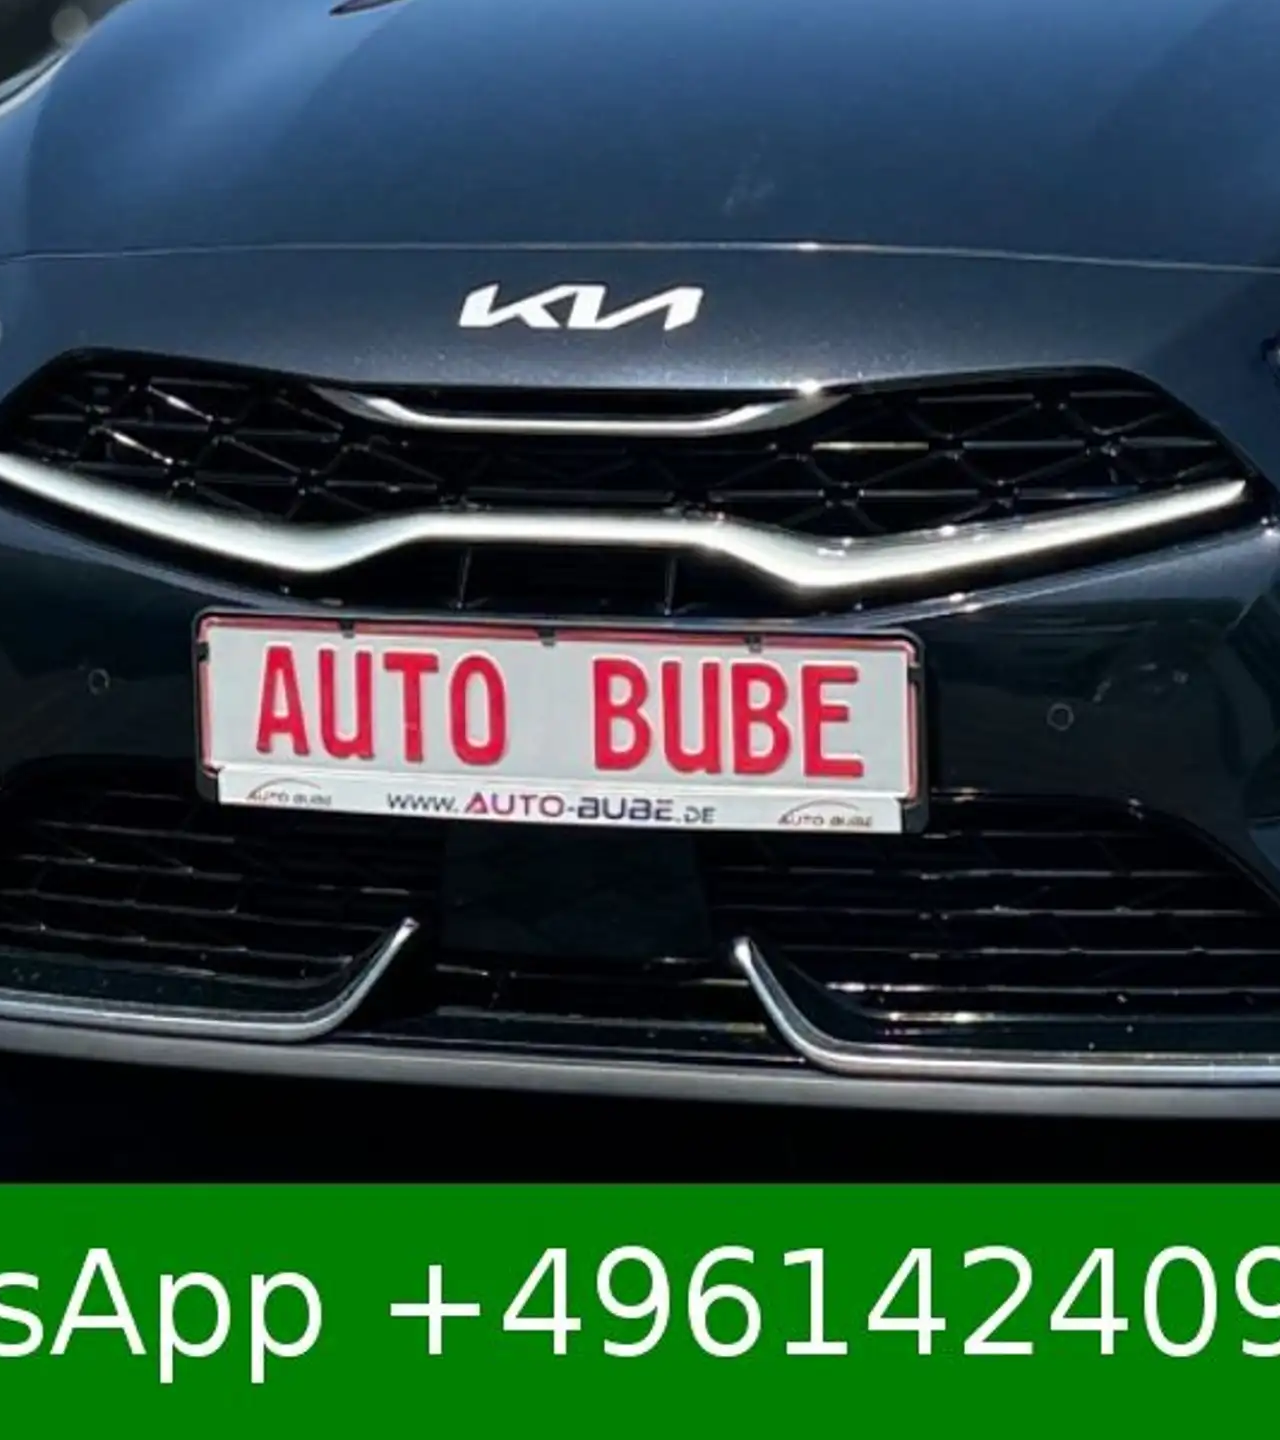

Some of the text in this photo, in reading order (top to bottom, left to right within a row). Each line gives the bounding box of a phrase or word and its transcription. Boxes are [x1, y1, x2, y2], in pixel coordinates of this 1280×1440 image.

[459, 283, 704, 331] KIA
[255, 645, 866, 779] AUTO BUBE
